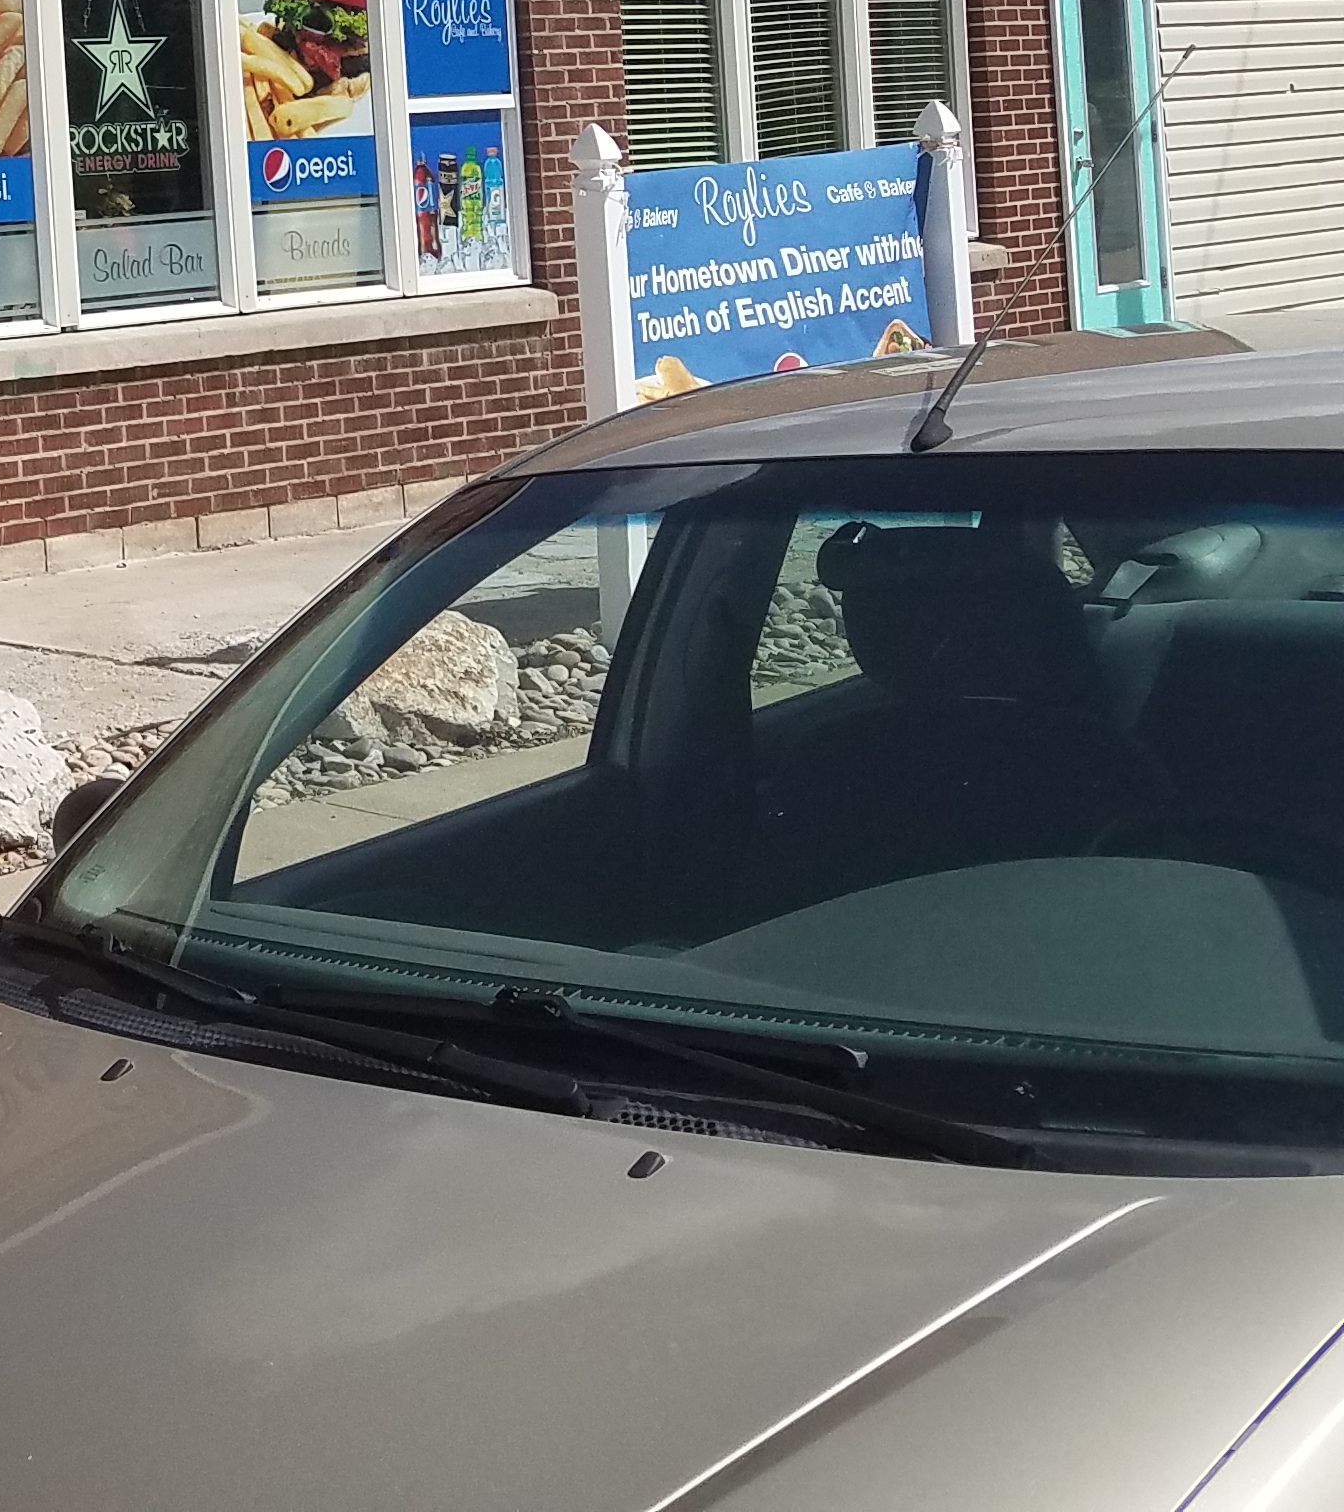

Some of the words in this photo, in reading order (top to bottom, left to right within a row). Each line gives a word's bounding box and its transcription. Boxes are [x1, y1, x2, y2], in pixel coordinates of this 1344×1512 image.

[76, 154, 132, 172] ENERGY
[138, 153, 179, 168] DRINK
[296, 150, 356, 186] pepsi
[643, 206, 678, 229] Bakery
[694, 166, 812, 247] Roylies
[826, 182, 864, 203] Café
[877, 178, 916, 197] Baker
[93, 246, 154, 282] Salad
[160, 243, 204, 276] Bar
[281, 228, 350, 261] Breads
[630, 271, 647, 299] ur
[652, 257, 777, 295] Hometown
[780, 244, 850, 278] Diner
[855, 233, 899, 265] with
[637, 306, 700, 343] Touch
[706, 301, 730, 333] of
[734, 287, 833, 330] English
[839, 276, 912, 313] Accent
